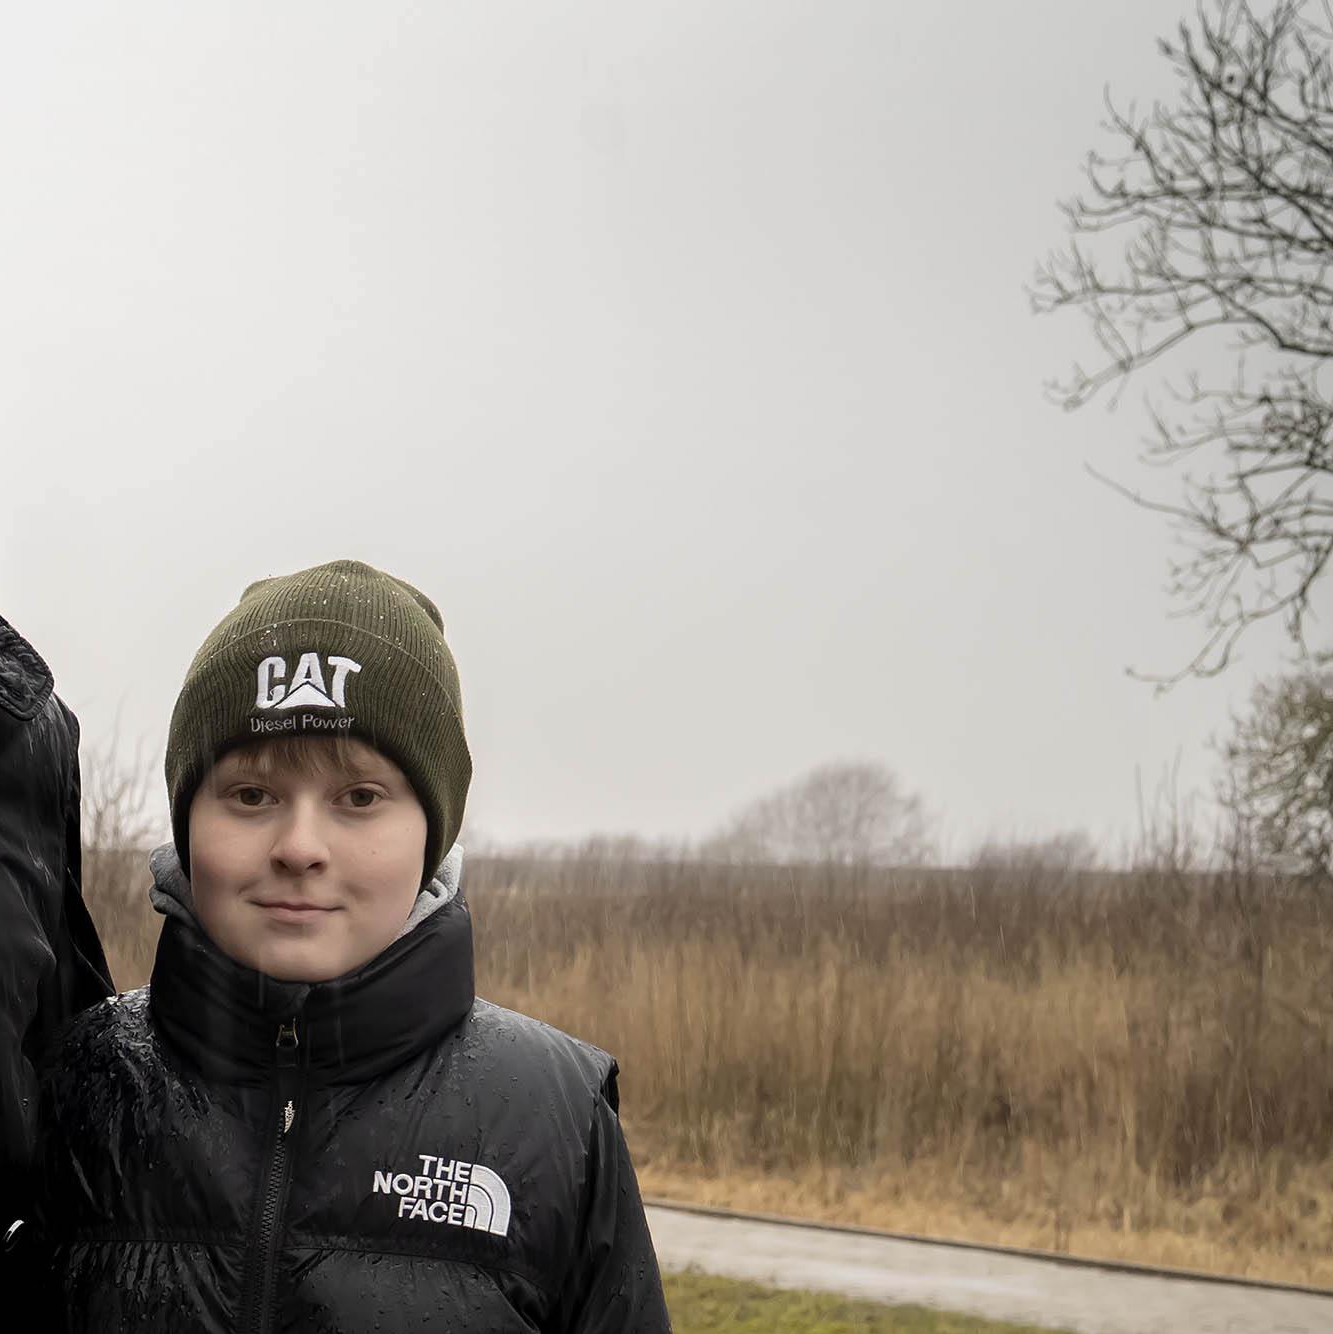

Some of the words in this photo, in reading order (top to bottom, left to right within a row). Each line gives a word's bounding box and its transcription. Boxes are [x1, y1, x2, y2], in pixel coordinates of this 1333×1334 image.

[256, 652, 362, 709] CAT
[250, 714, 296, 733] Diesel
[302, 713, 355, 729] Power
[418, 1154, 472, 1183] THE
[372, 1170, 468, 1204] NORTH
[397, 1196, 465, 1226] FACE
